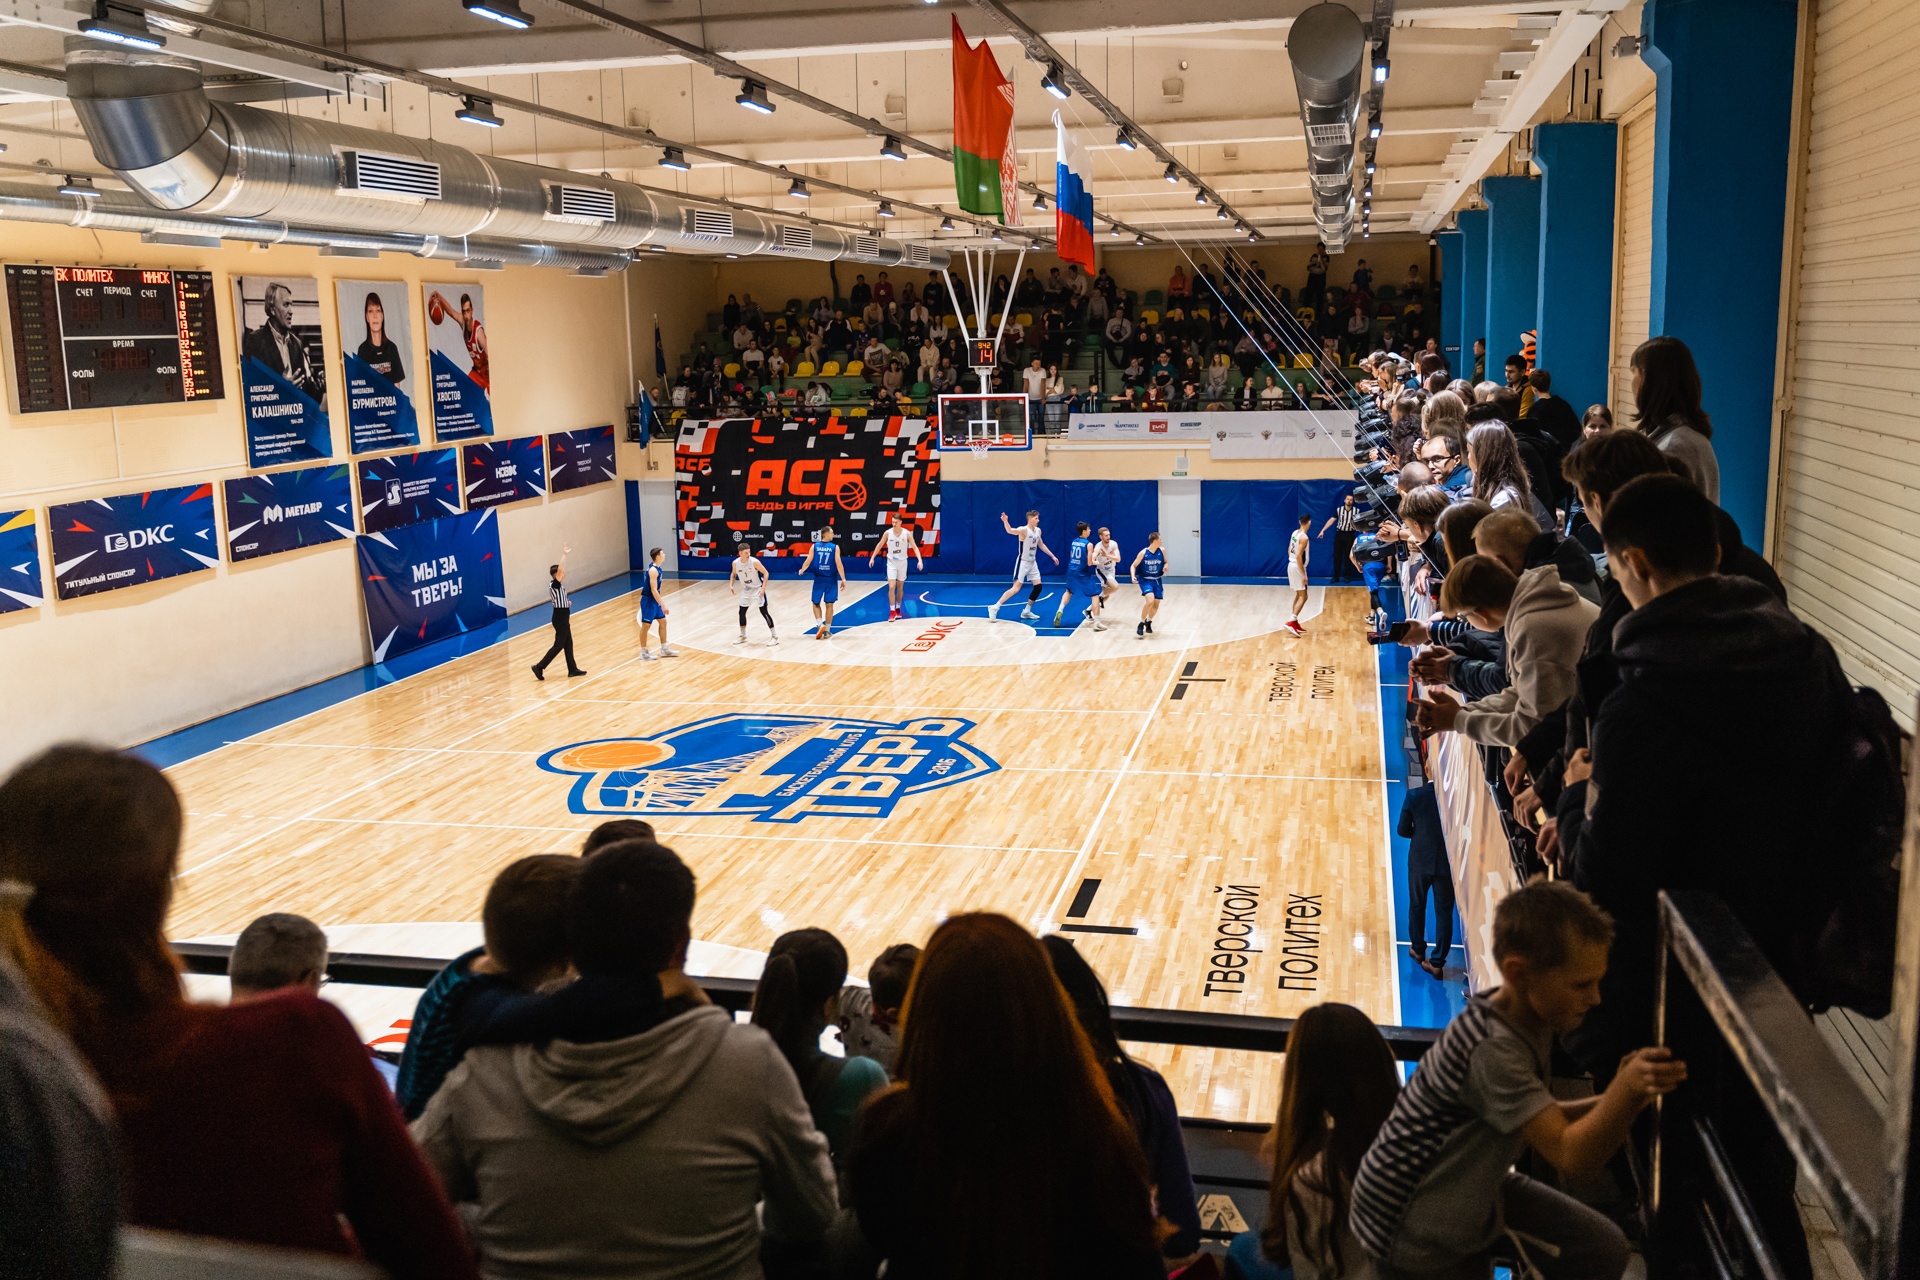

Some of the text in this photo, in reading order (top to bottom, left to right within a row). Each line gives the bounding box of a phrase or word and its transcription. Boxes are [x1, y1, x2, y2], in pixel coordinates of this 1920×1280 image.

[72, 269, 113, 282] ПОЛИТЕХ
[142, 271, 170, 284] МИНСК
[76, 288, 93, 296] СЧЕТ
[104, 286, 132, 296] ПЕРИОД
[981, 349, 992, 362] 14
[72, 370, 94, 378] ФОЛЫ
[352, 396, 397, 410] БУРМИСТРОВА
[437, 391, 461, 402] ХВОСТОВ
[252, 403, 303, 418] КАЛАШНИКОВ
[745, 459, 865, 496] АСБ
[285, 502, 322, 518] МЕТАВР
[746, 501, 834, 511] БУДЬ В ИГРЕ
[129, 524, 175, 549] DKC
[235, 542, 259, 553] СПОНСОР
[818, 552, 830, 564] 77
[411, 555, 458, 583] МЫ ЗА
[65, 568, 136, 589] ТИТУЛЬНЫЙ СПОНСОР
[411, 576, 462, 608] ТВЕРЬ!
[915, 621, 963, 640] DKC
[776, 733, 864, 797] БАСКЕТБОЛЬНЫЙ КЛУБ
